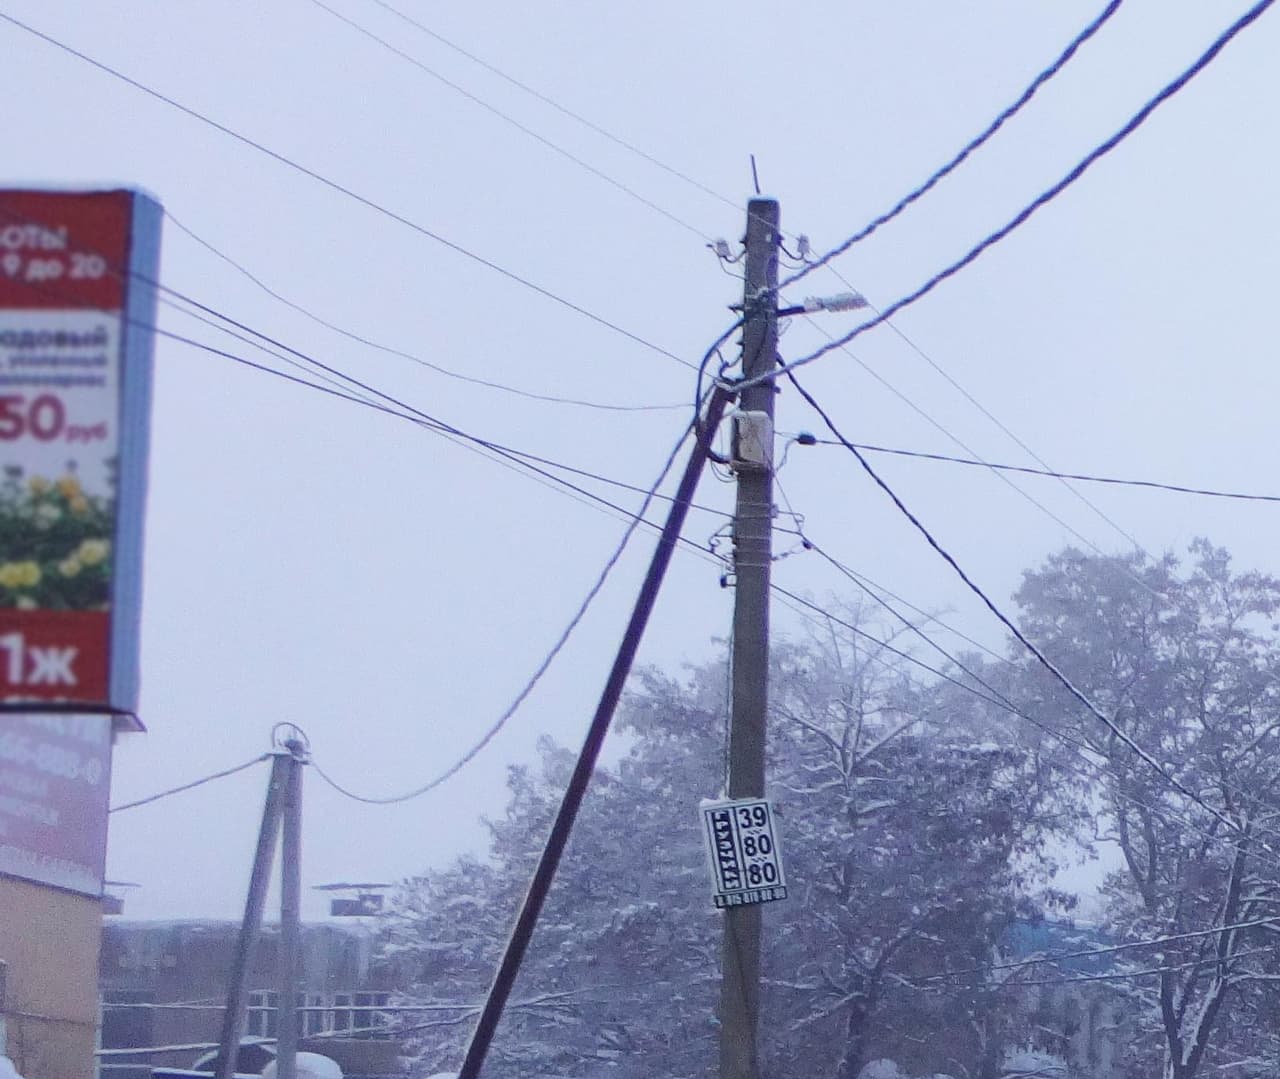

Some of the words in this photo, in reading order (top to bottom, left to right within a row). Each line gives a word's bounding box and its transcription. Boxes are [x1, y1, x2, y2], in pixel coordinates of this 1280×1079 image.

[68, 252, 107, 279] 20
[739, 806, 767, 829] 39
[743, 834, 771, 857] 80
[750, 862, 777, 885] 80
